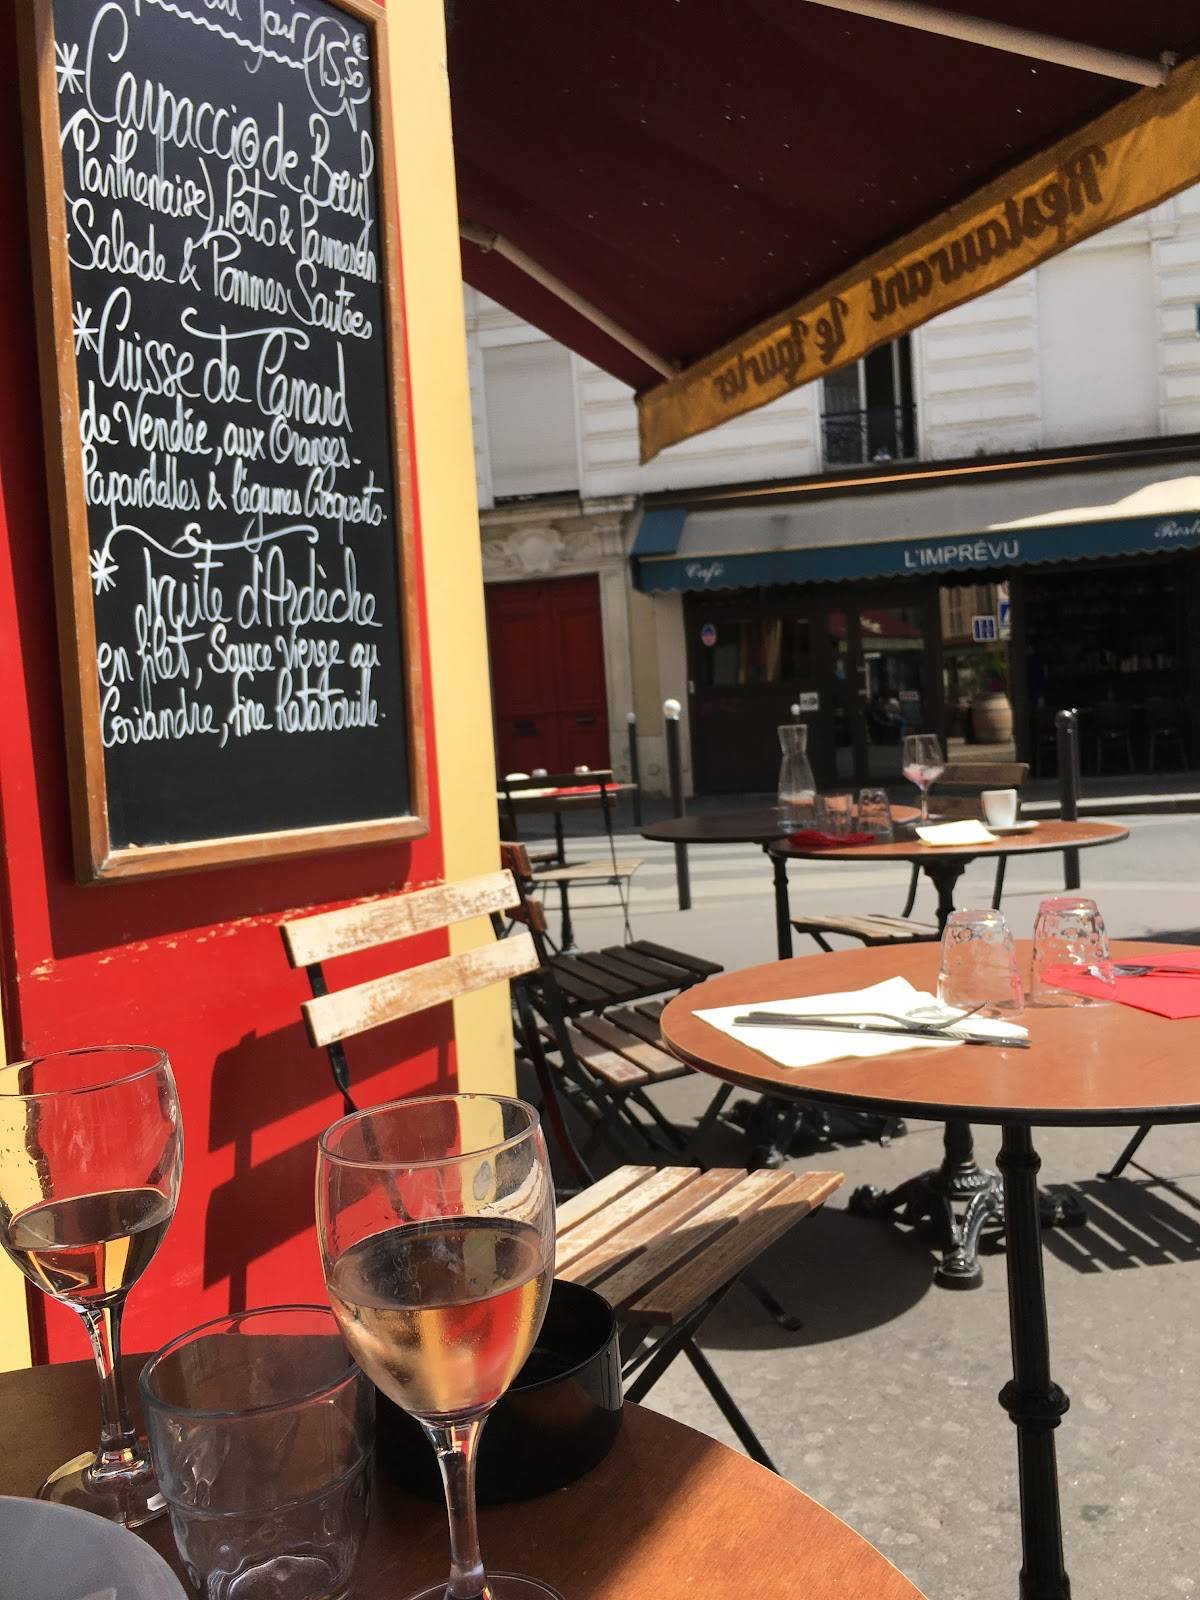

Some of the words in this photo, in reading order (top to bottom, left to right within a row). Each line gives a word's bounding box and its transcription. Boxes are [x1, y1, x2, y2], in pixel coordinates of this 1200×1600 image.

[86, 2, 260, 182] Carpaccio
[263, 102, 303, 193] de
[68, 198, 175, 284] Salade
[178, 237, 202, 291] &
[204, 230, 288, 316] Pommes
[288, 262, 373, 340] Sautées
[280, 204, 297, 254] &
[98, 287, 201, 398] Cuisse
[203, 324, 253, 404] de
[256, 328, 354, 433] Canard
[80, 380, 119, 447] de
[223, 418, 267, 461] aux
[208, 471, 228, 511] &
[238, 545, 384, 629] d'Ardèche
[904, 540, 1019, 568] L'IMPRÉVU
[98, 642, 135, 688] en
[208, 623, 276, 674] Sauce
[349, 643, 381, 668] au
